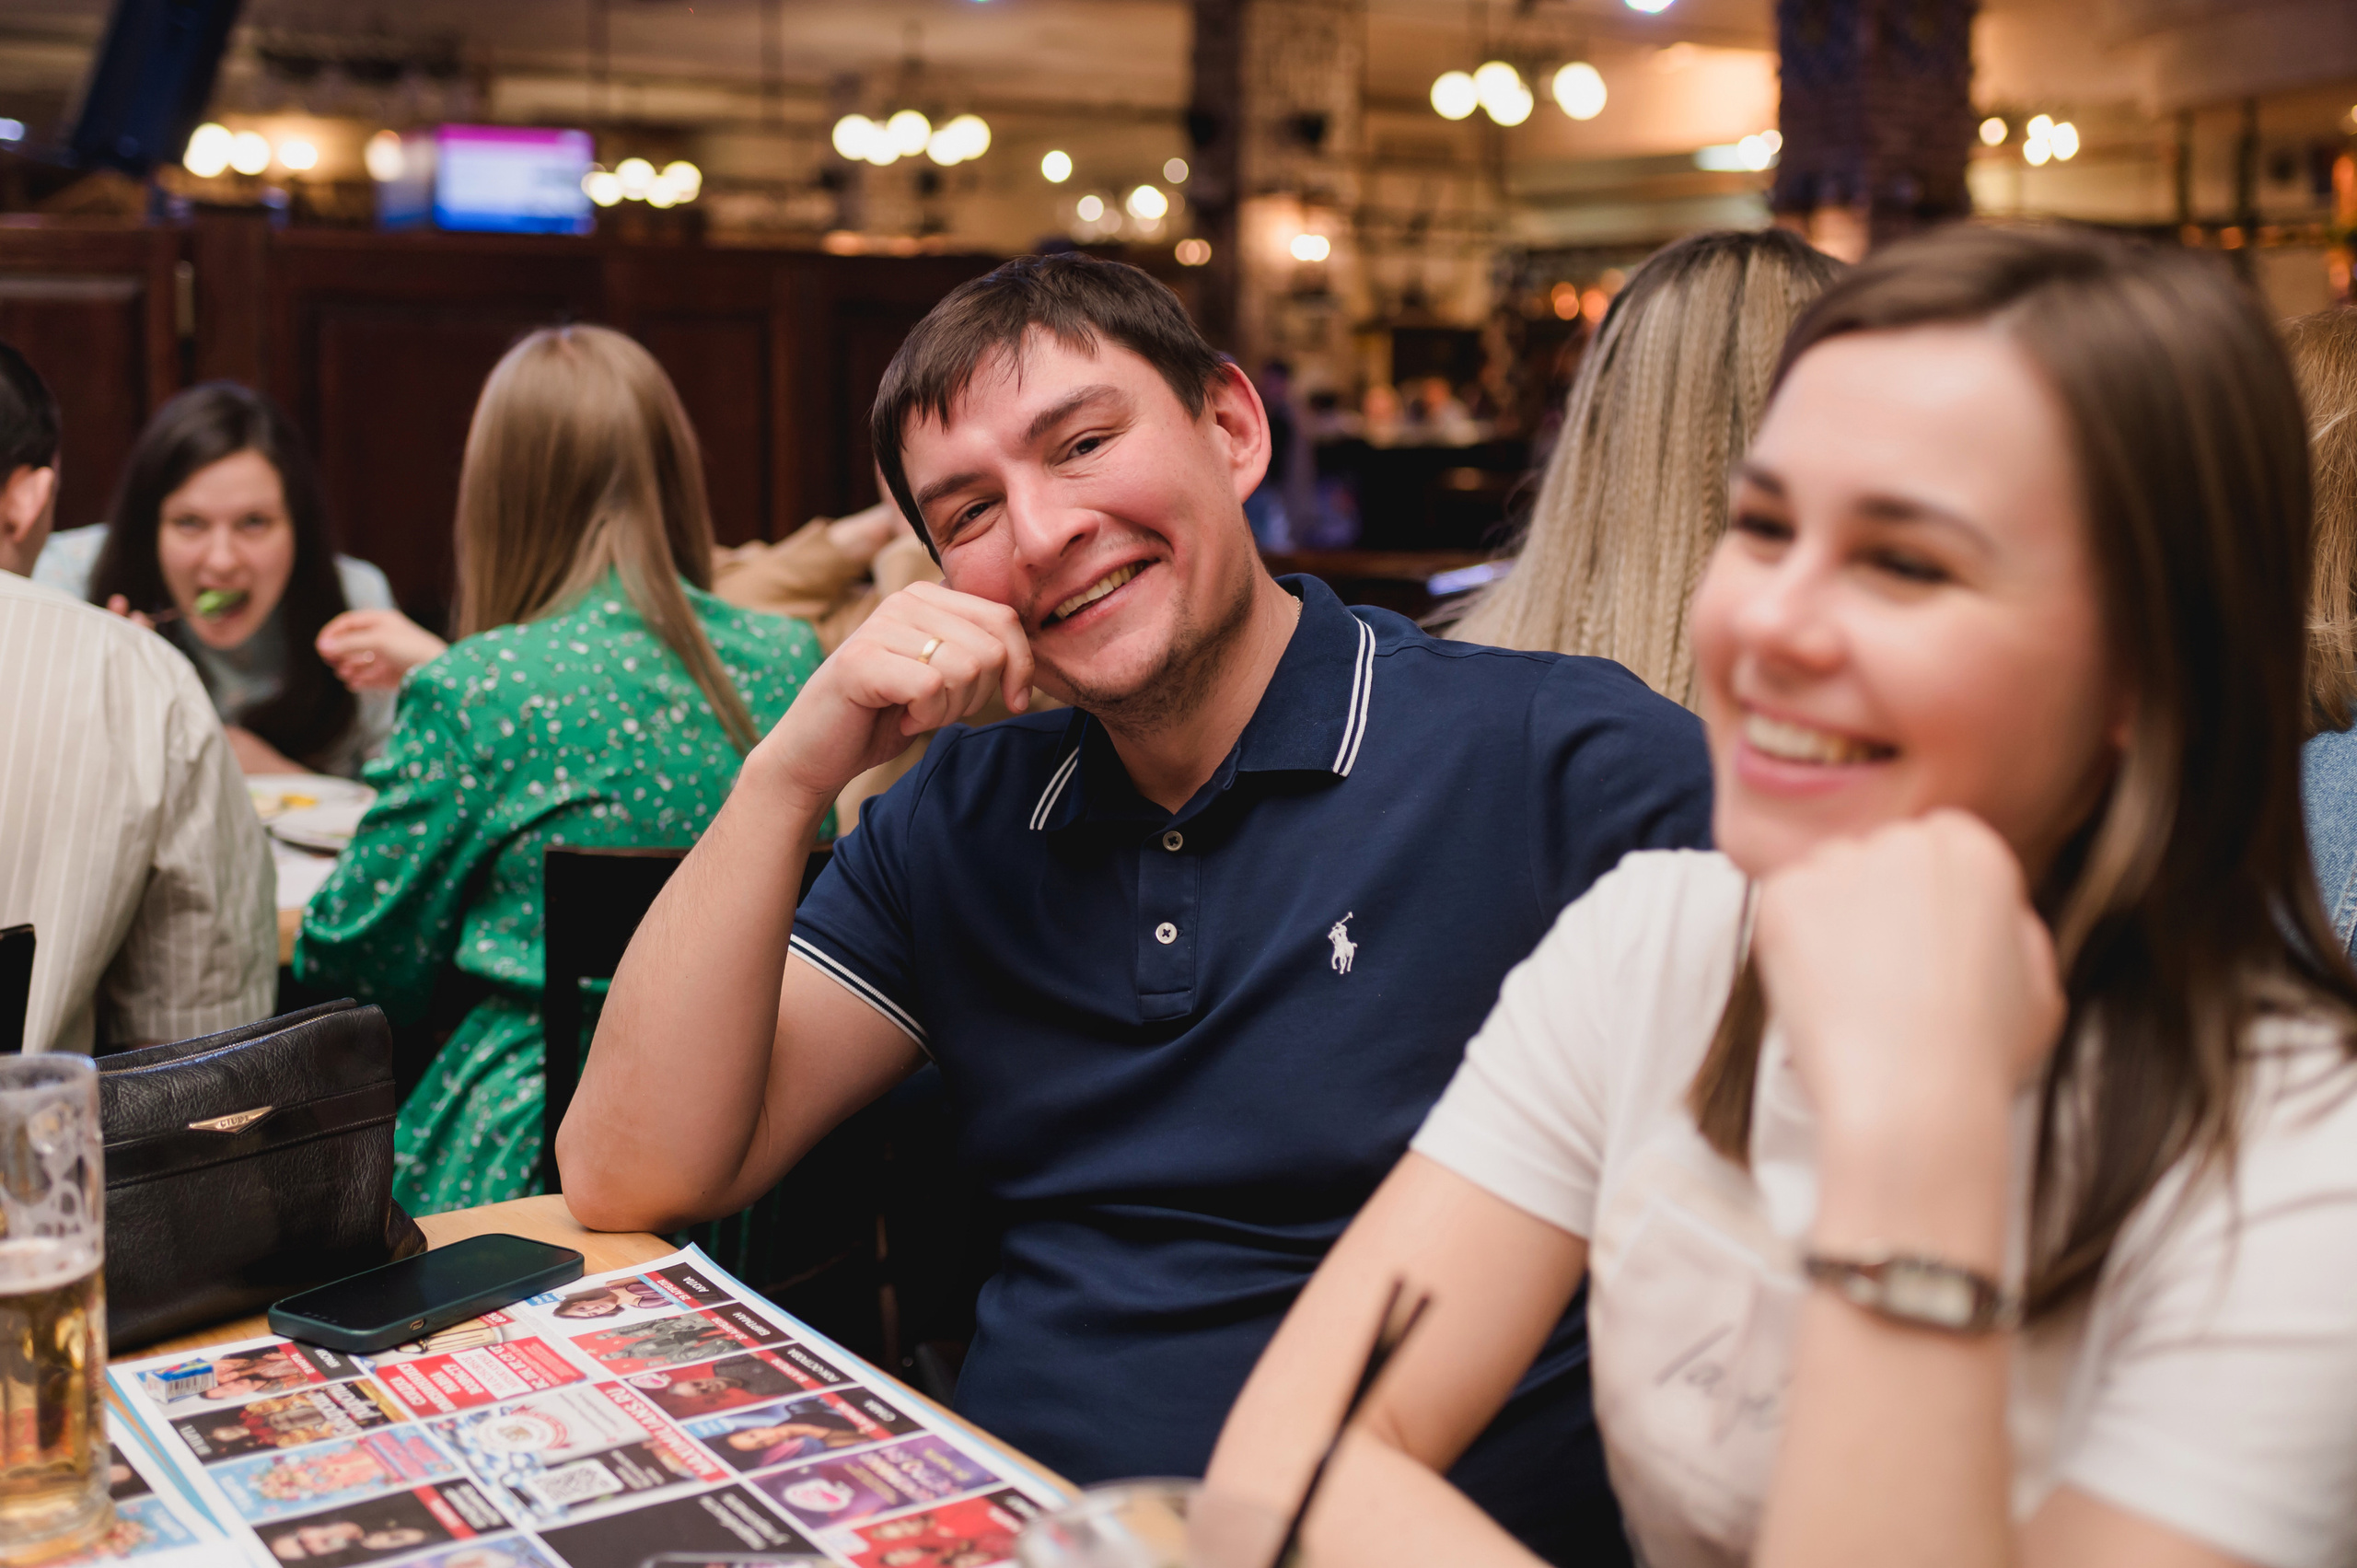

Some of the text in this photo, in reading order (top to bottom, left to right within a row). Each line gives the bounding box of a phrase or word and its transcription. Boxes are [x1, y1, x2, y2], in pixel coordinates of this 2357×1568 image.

[656, 1279, 685, 1295] АПРЕЛЯ
[681, 1276, 710, 1292] АКУЛА
[711, 1317, 741, 1333] АПРЕЛЯ
[732, 1312, 772, 1335] БИРТМАН
[431, 1371, 460, 1393] РАВНА
[444, 1364, 484, 1394] ВОЗРАСТУ
[391, 1376, 428, 1405] СКИДКА
[608, 1387, 718, 1475] MAXIMILIANS.RU
